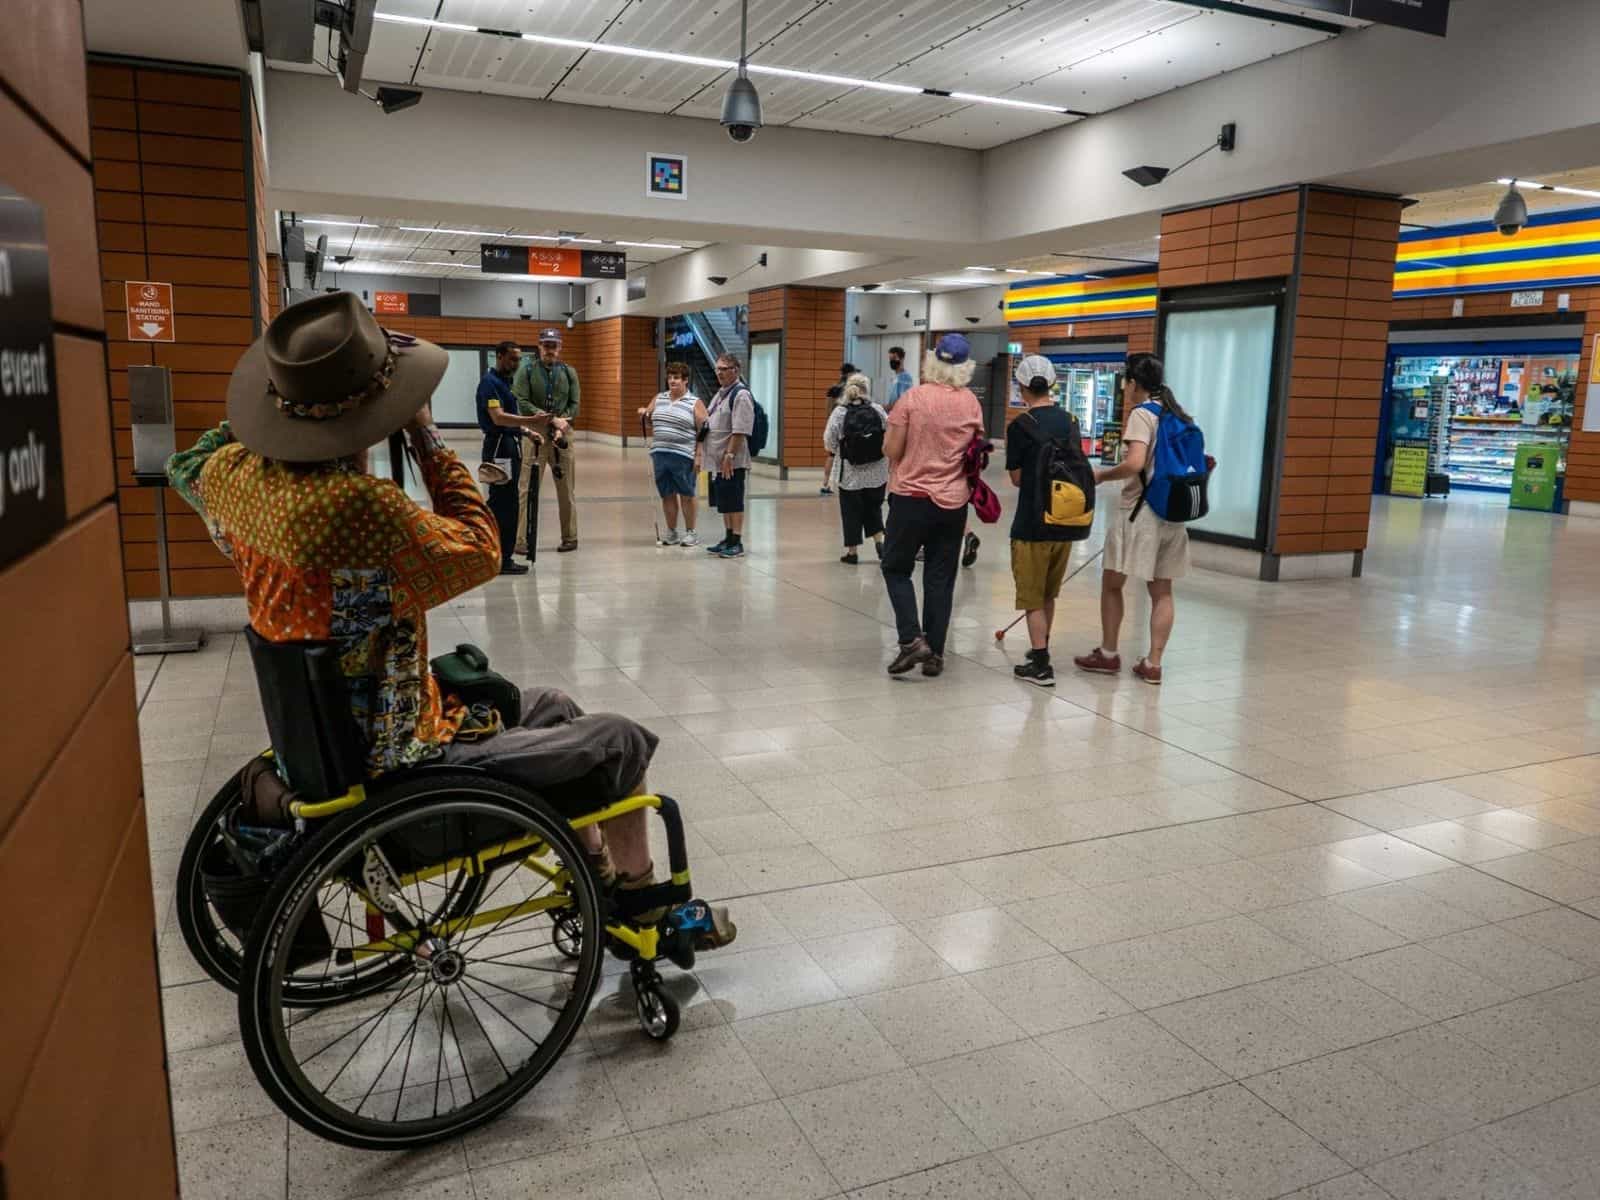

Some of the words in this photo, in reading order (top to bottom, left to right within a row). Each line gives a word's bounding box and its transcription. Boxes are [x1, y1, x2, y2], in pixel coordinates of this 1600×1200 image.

[552, 263, 560, 272] 2
[1, 343, 48, 396] event
[9, 431, 45, 500] only
